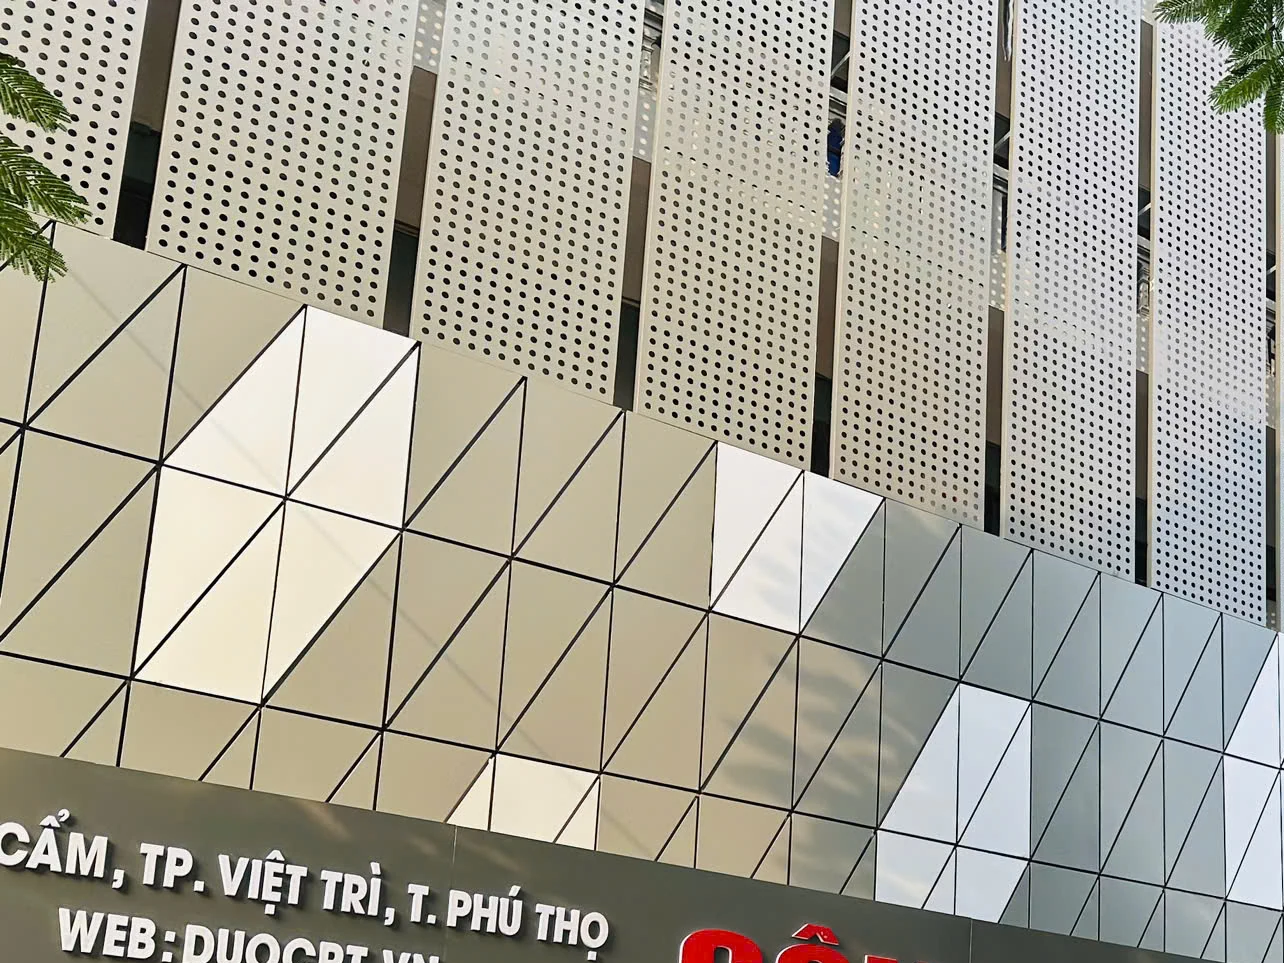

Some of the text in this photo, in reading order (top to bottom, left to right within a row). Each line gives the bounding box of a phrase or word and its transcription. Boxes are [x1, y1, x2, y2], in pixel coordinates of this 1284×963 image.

[0, 809, 610, 961] CẨM, TP. VIỆT TRÌ, T. PHÚ THỌ
